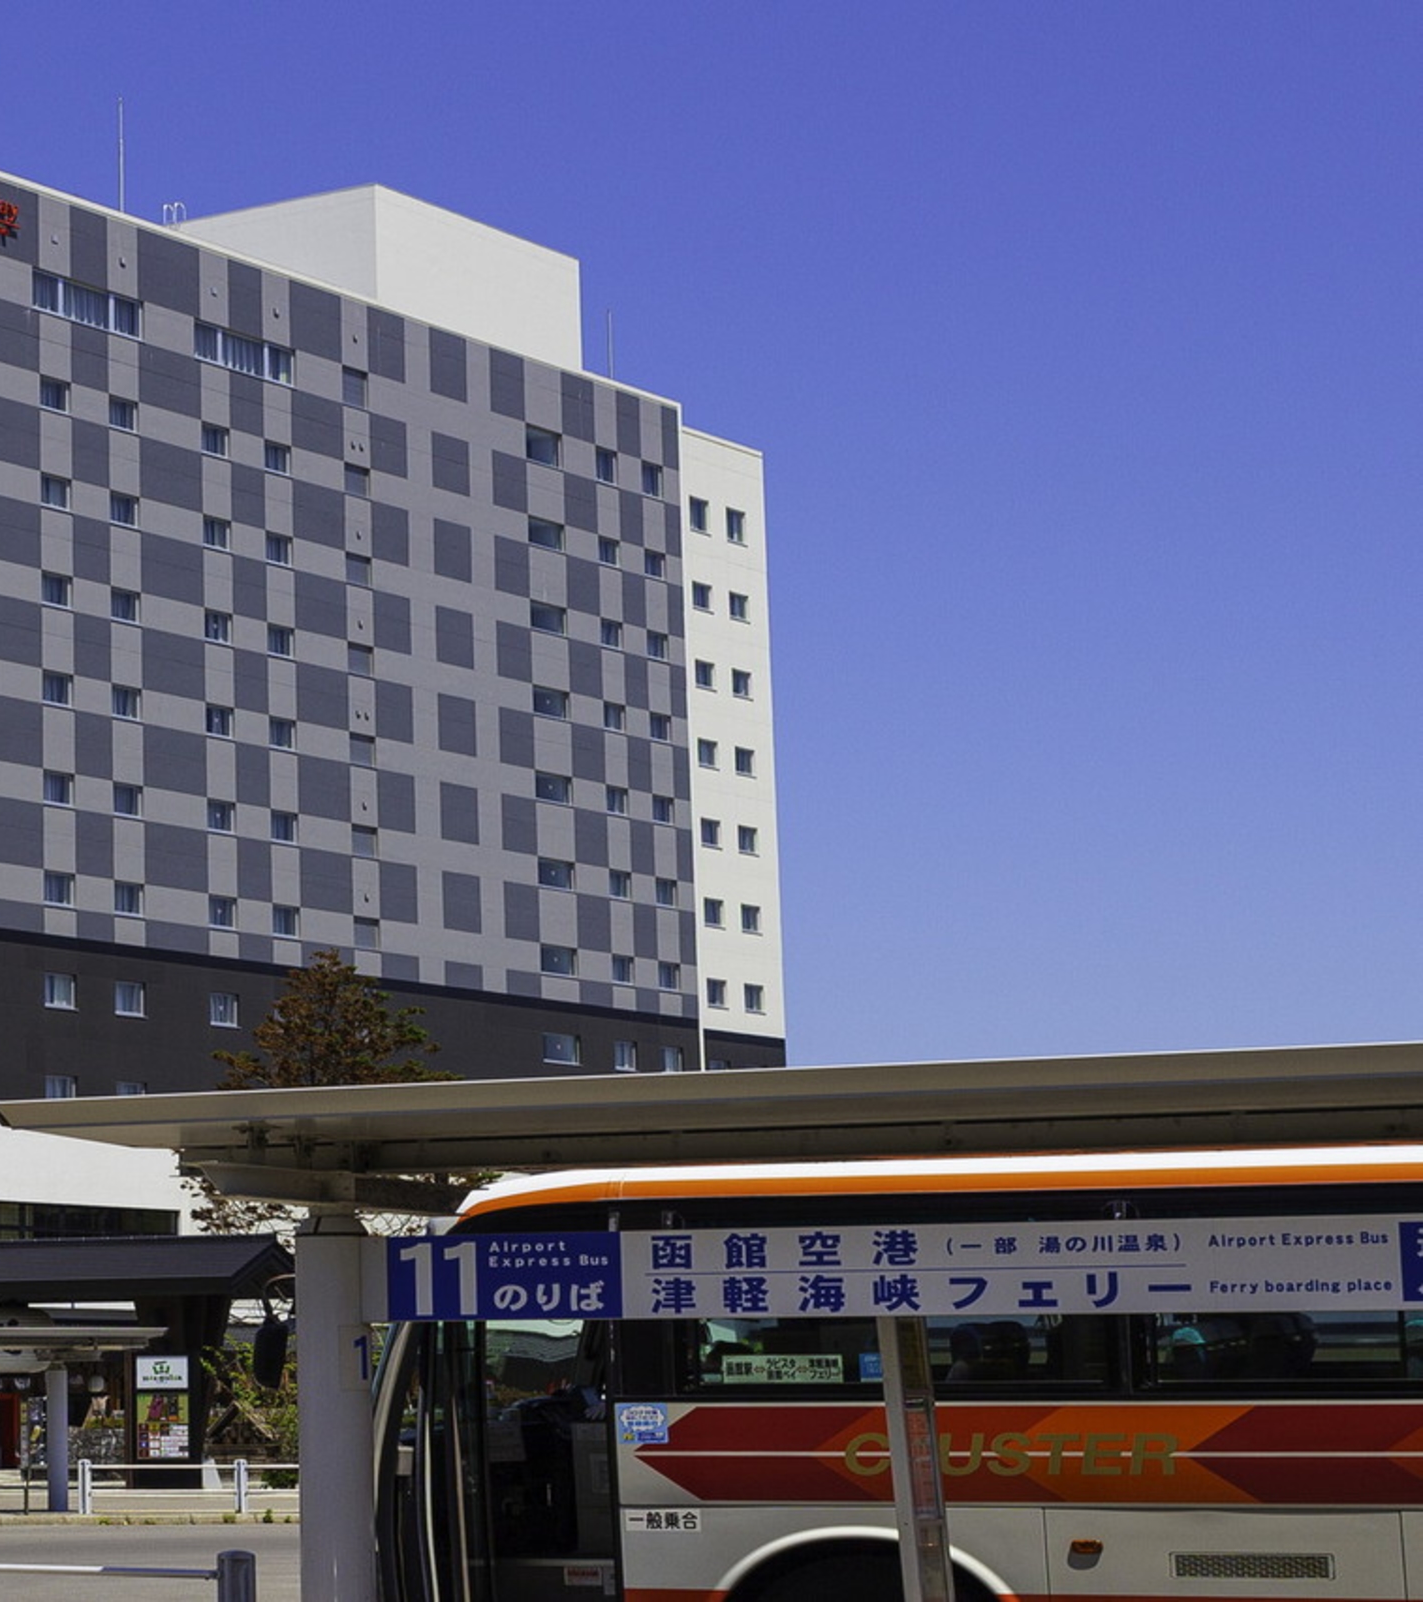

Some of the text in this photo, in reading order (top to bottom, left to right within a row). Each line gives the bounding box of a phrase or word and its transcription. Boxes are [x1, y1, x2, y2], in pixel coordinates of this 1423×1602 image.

[489, 1241, 566, 1253] Airport
[651, 1231, 918, 1270] 函館空港
[1208, 1231, 1389, 1248] Airport Express Bus
[489, 1254, 608, 1268] Express Bus
[399, 1241, 478, 1317] 11
[1209, 1278, 1393, 1294] Ferry boarding place
[493, 1280, 605, 1312] のりば
[651, 1271, 1192, 1314] 津軽海峡フェリー
[844, 1432, 1180, 1477] CUSTER
[628, 1511, 699, 1530] 一般乗合
